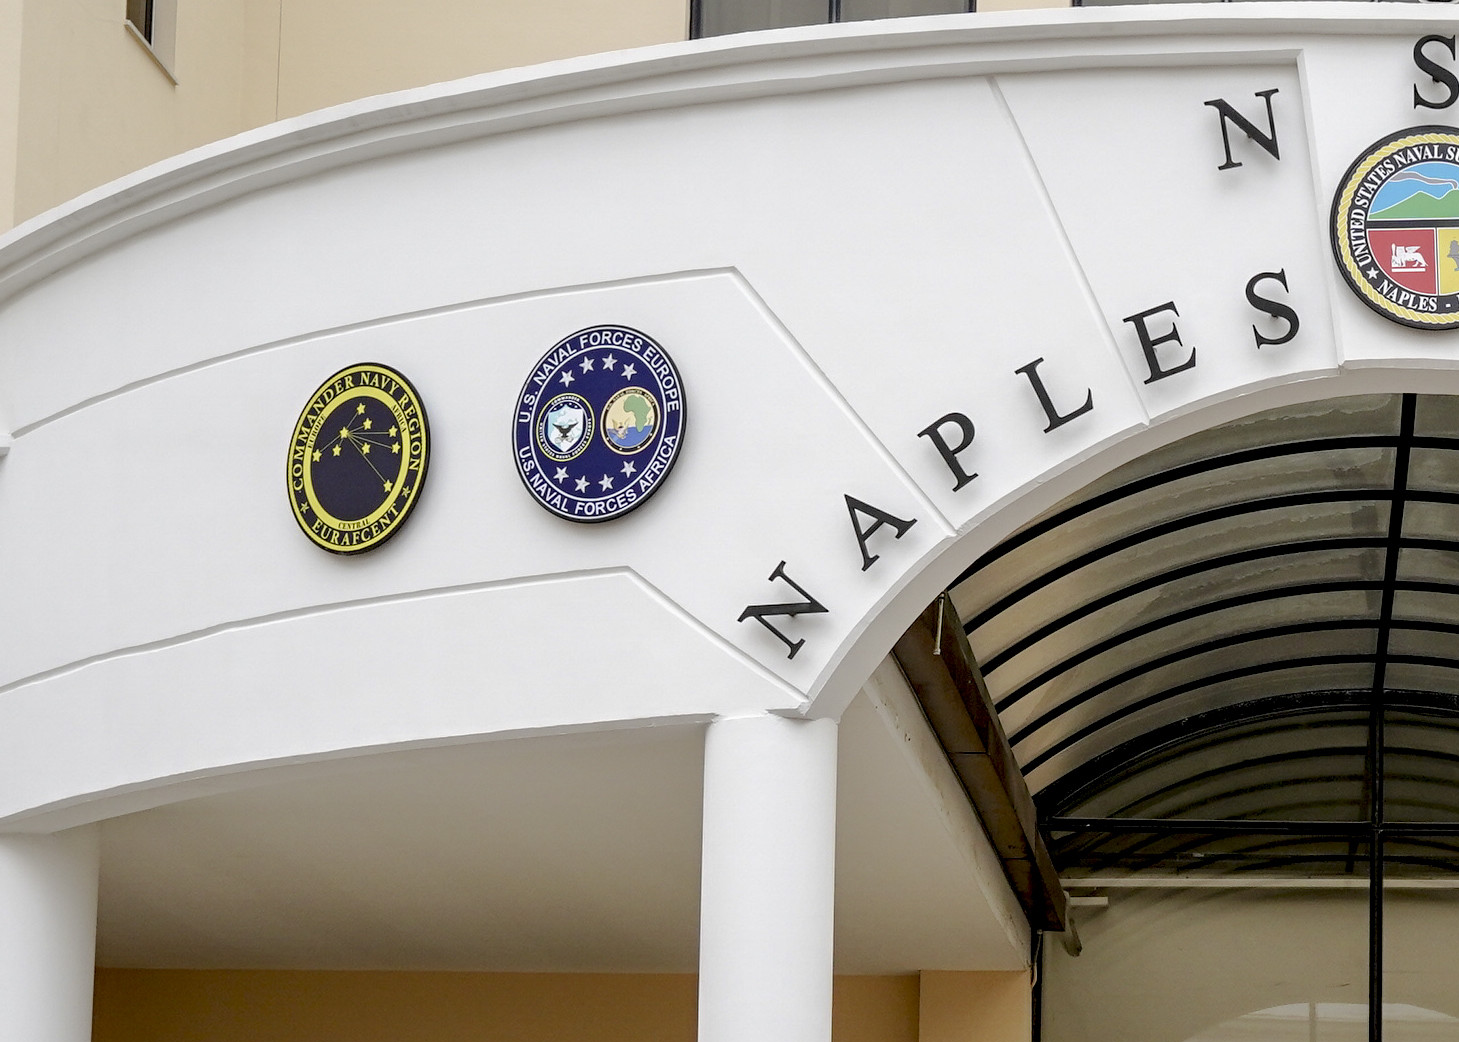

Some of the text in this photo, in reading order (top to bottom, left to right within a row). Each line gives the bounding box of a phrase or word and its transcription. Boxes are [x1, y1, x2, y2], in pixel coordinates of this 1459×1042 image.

[1393, 144, 1444, 169] NAVAL
[1354, 157, 1397, 209] STATES
[1351, 208, 1373, 268] UNITED
[1376, 279, 1438, 312] NAPLES
[519, 390, 539, 423] U.S.
[533, 343, 577, 386] NAVAL
[579, 331, 643, 352] FORCES
[643, 344, 680, 413] EUROPE
[293, 372, 422, 492] COMMANDER NAVY REGION
[306, 413, 327, 450] EUROPE
[391, 404, 408, 434] AFRICA
[519, 434, 677, 516] U.S. NAVAL FORCES AFRICA
[737, 268, 1300, 660] NAPLES
[311, 502, 400, 546] EURAFCENT
